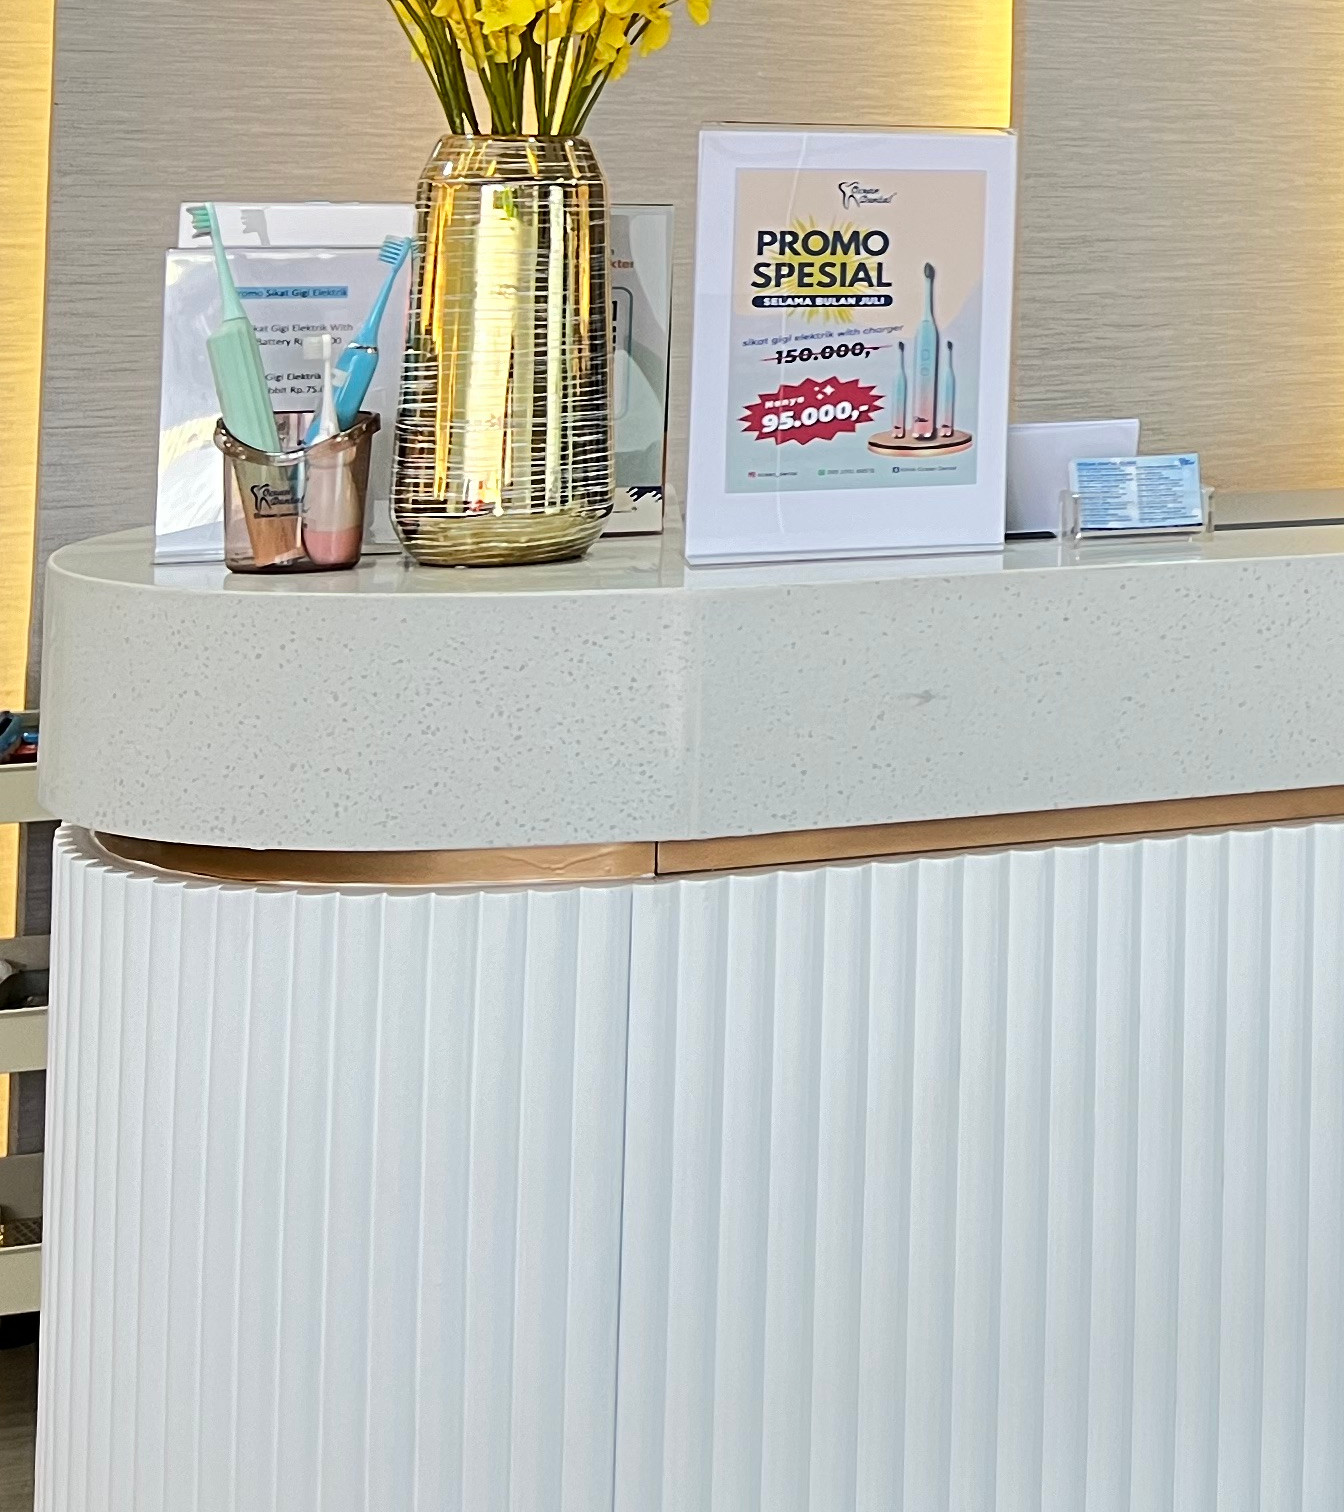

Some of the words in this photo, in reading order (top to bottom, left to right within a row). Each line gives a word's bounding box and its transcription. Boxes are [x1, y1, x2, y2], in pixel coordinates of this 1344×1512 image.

[757, 229, 890, 257] PROMO
[751, 261, 893, 289] SPESIAL
[265, 289, 289, 297] Sikat
[291, 288, 310, 298] Gigi
[312, 287, 347, 297] Elektrik
[763, 297, 812, 306] SELAMA
[815, 296, 856, 306] BULAN
[858, 296, 886, 305] JULI
[271, 324, 290, 334] Gigi
[292, 323, 327, 332] Elektrik
[330, 323, 354, 331] With
[742, 337, 769, 347] sikat
[771, 334, 792, 345] gigi
[794, 331, 834, 341] elektrik
[837, 328, 861, 337] with
[862, 324, 905, 335] charger
[761, 401, 870, 434] 95.000,-
